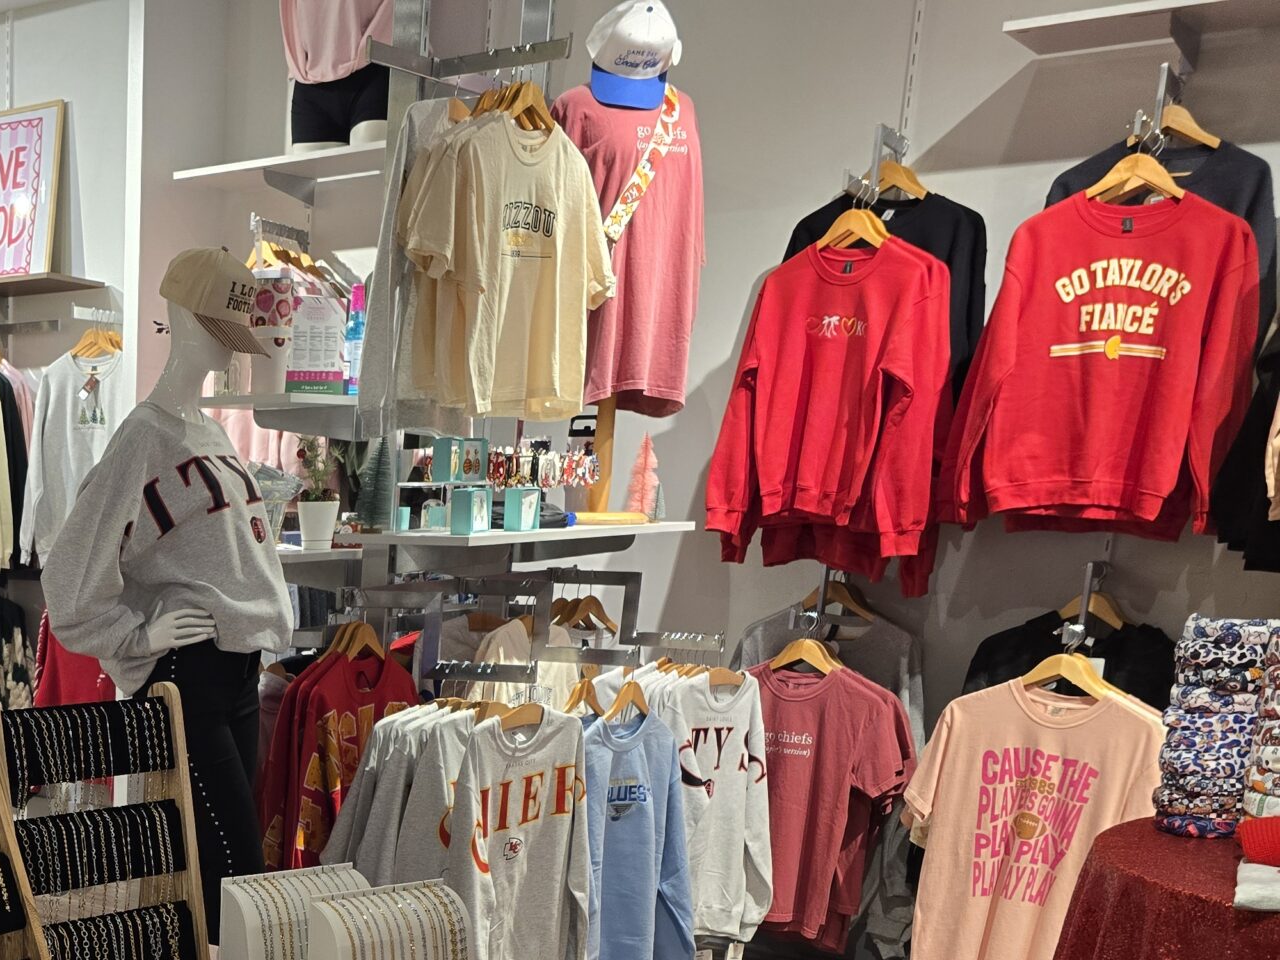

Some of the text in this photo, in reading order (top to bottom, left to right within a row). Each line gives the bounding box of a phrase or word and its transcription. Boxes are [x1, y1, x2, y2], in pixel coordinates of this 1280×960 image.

[637, 126, 651, 138] go
[230, 281, 237, 293] I
[1055, 258, 1192, 306] GO TAYLOR'S
[1079, 301, 1159, 334] FIANCÉ
[765, 731, 813, 745] go chiefs
[783, 747, 811, 758] version)
[981, 747, 1099, 804] CAUSE THE
[607, 785, 647, 803] LUES
[1037, 795, 1084, 850] GONNA
[1014, 834, 1067, 871] PLAY
[972, 861, 1002, 897] PLA
[1021, 867, 1057, 907] PLAY
